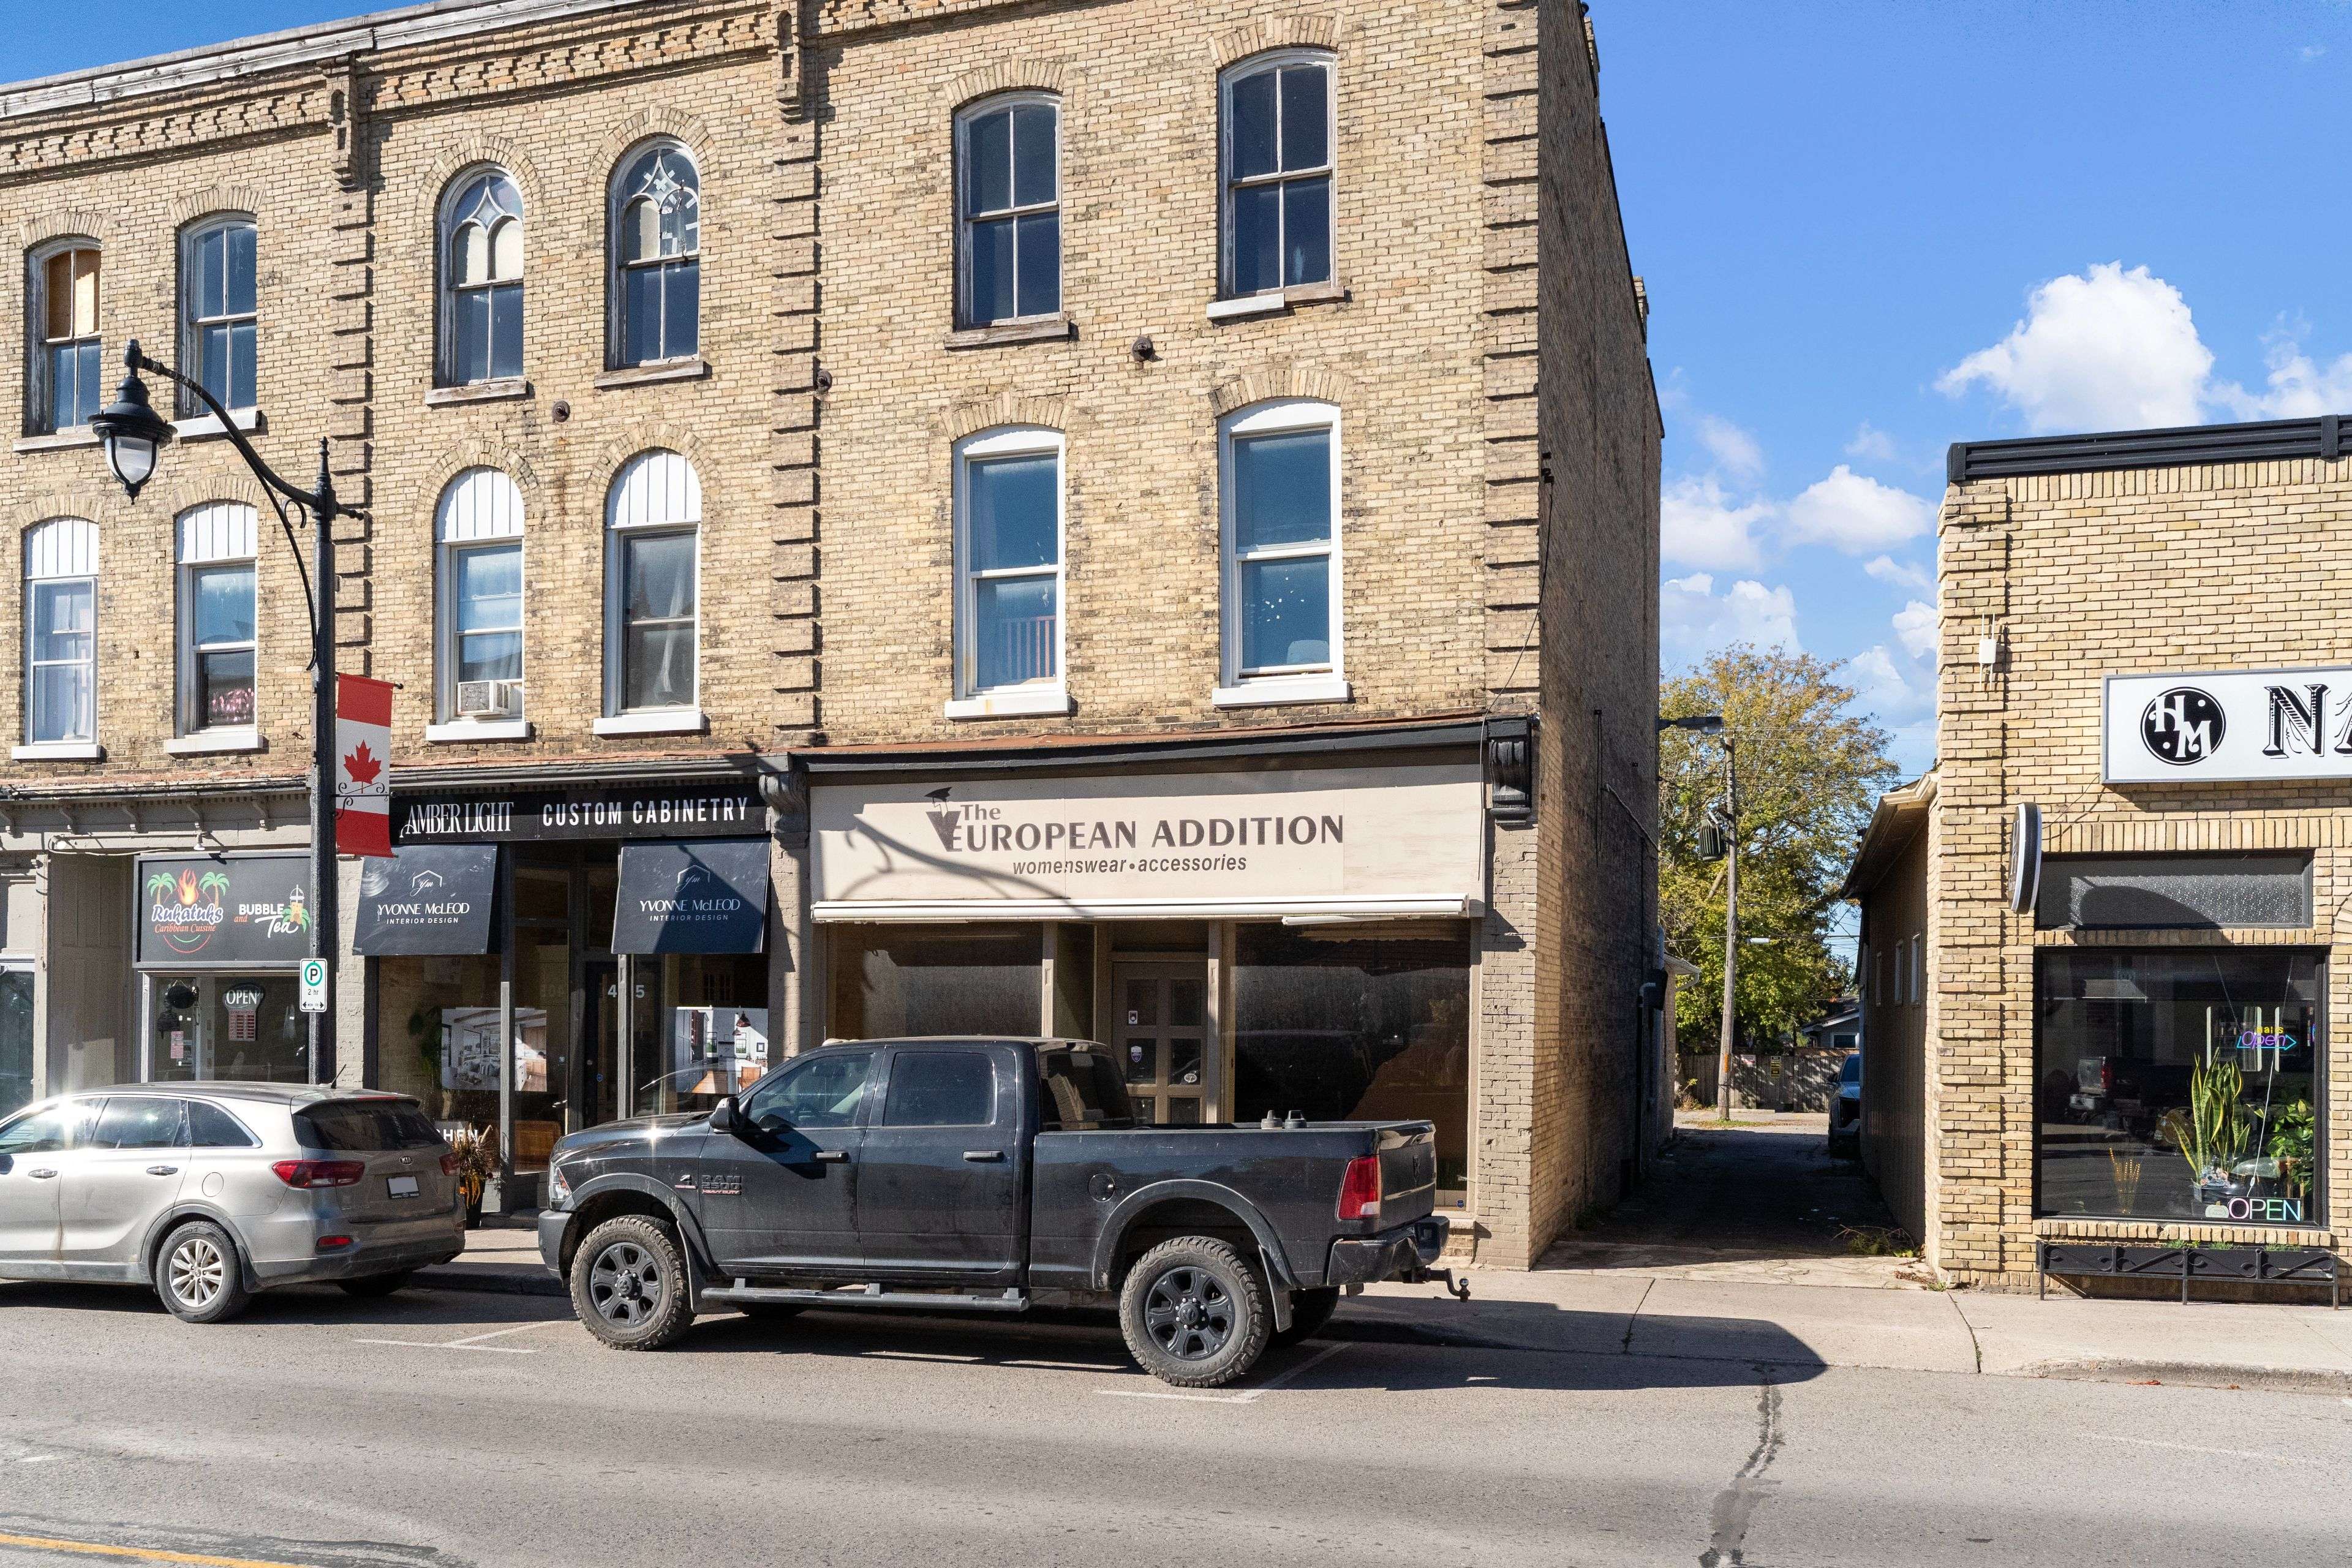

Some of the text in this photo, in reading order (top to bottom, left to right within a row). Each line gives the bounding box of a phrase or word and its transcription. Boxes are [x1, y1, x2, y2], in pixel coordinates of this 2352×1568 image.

[2262, 684, 2352, 760] N
[399, 802, 514, 838] AMBER LIGHT
[543, 797, 748, 826] CUSTOM CABINETRY
[960, 804, 1001, 821] The
[947, 815, 1343, 852] EUROPEAN ADDITION
[152, 903, 224, 925] Rukatuks
[239, 903, 285, 916] BUBBLE
[378, 902, 470, 915] YVONNE McLEOD
[639, 899, 741, 912] YVONNE McLEOD
[234, 914, 247, 923] and
[254, 914, 299, 938] Tea
[154, 923, 216, 933] Caribbean Cuisine
[310, 968, 318, 981] P
[226, 989, 257, 1005] OPEN
[2242, 1031, 2286, 1049] Open
[2228, 1197, 2301, 1221] OPEN
